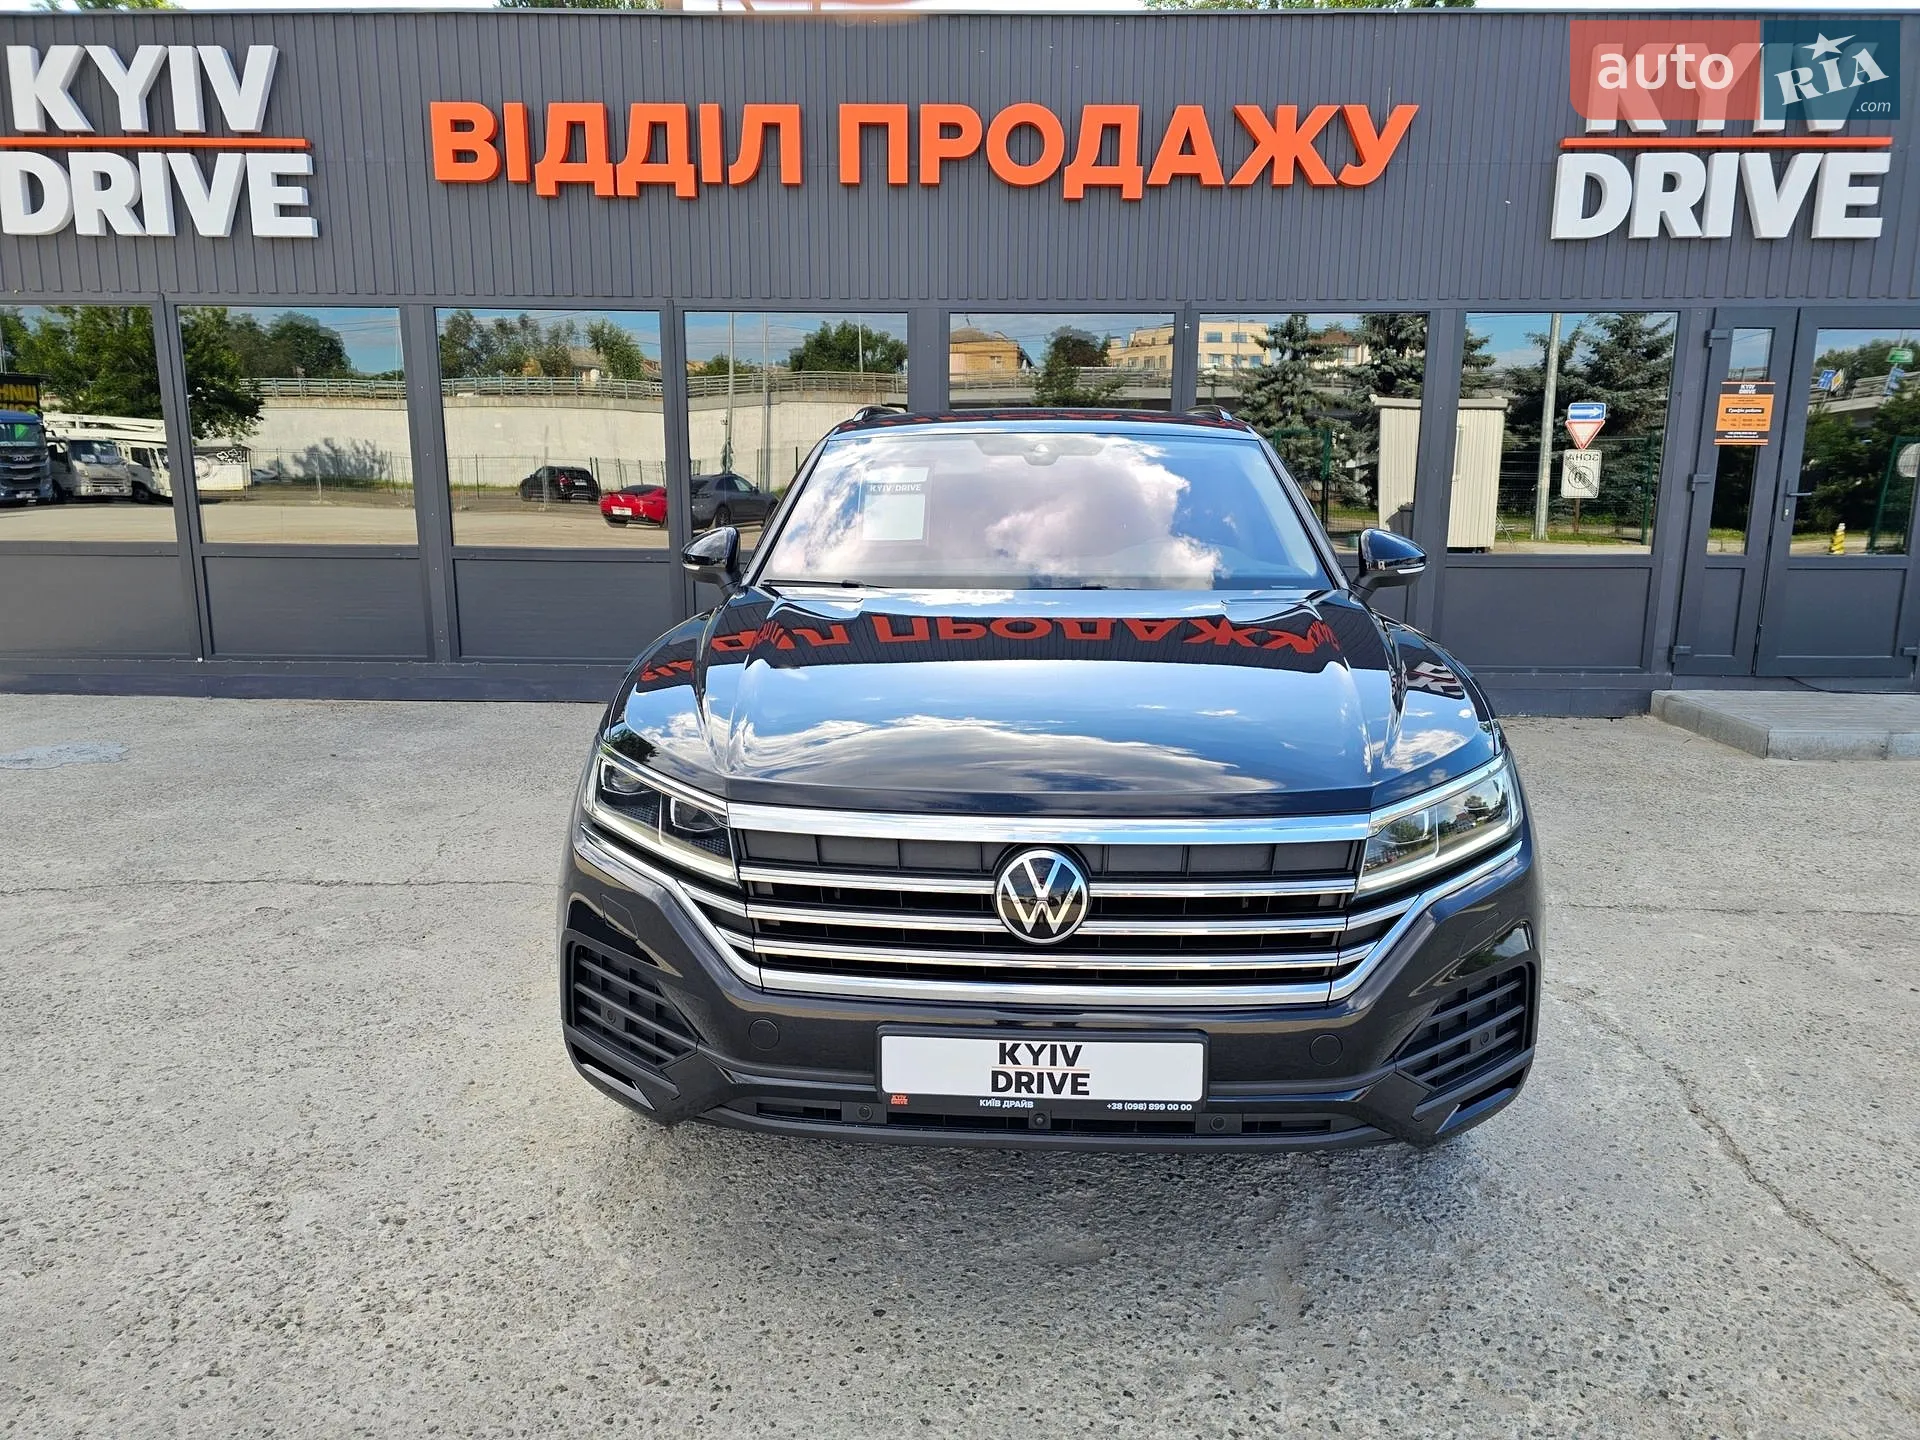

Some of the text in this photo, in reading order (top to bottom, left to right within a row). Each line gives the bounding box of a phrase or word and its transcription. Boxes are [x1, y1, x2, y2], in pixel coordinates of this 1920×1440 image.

[6, 45, 280, 134] KYIV
[430, 101, 1419, 202] ВІДДІЛ ПРОДАЖУ
[0, 152, 319, 238] DRIVE
[1551, 152, 1892, 240] DRIVE
[870, 483, 921, 492] KYIV DRIVE
[998, 1042, 1083, 1066] KYIV
[991, 1070, 1091, 1095] DRIVE
[979, 1099, 1034, 1109] КИЇВ ДРАЙВ
[1106, 1102, 1193, 1111] +38 (098) 899 00 00
